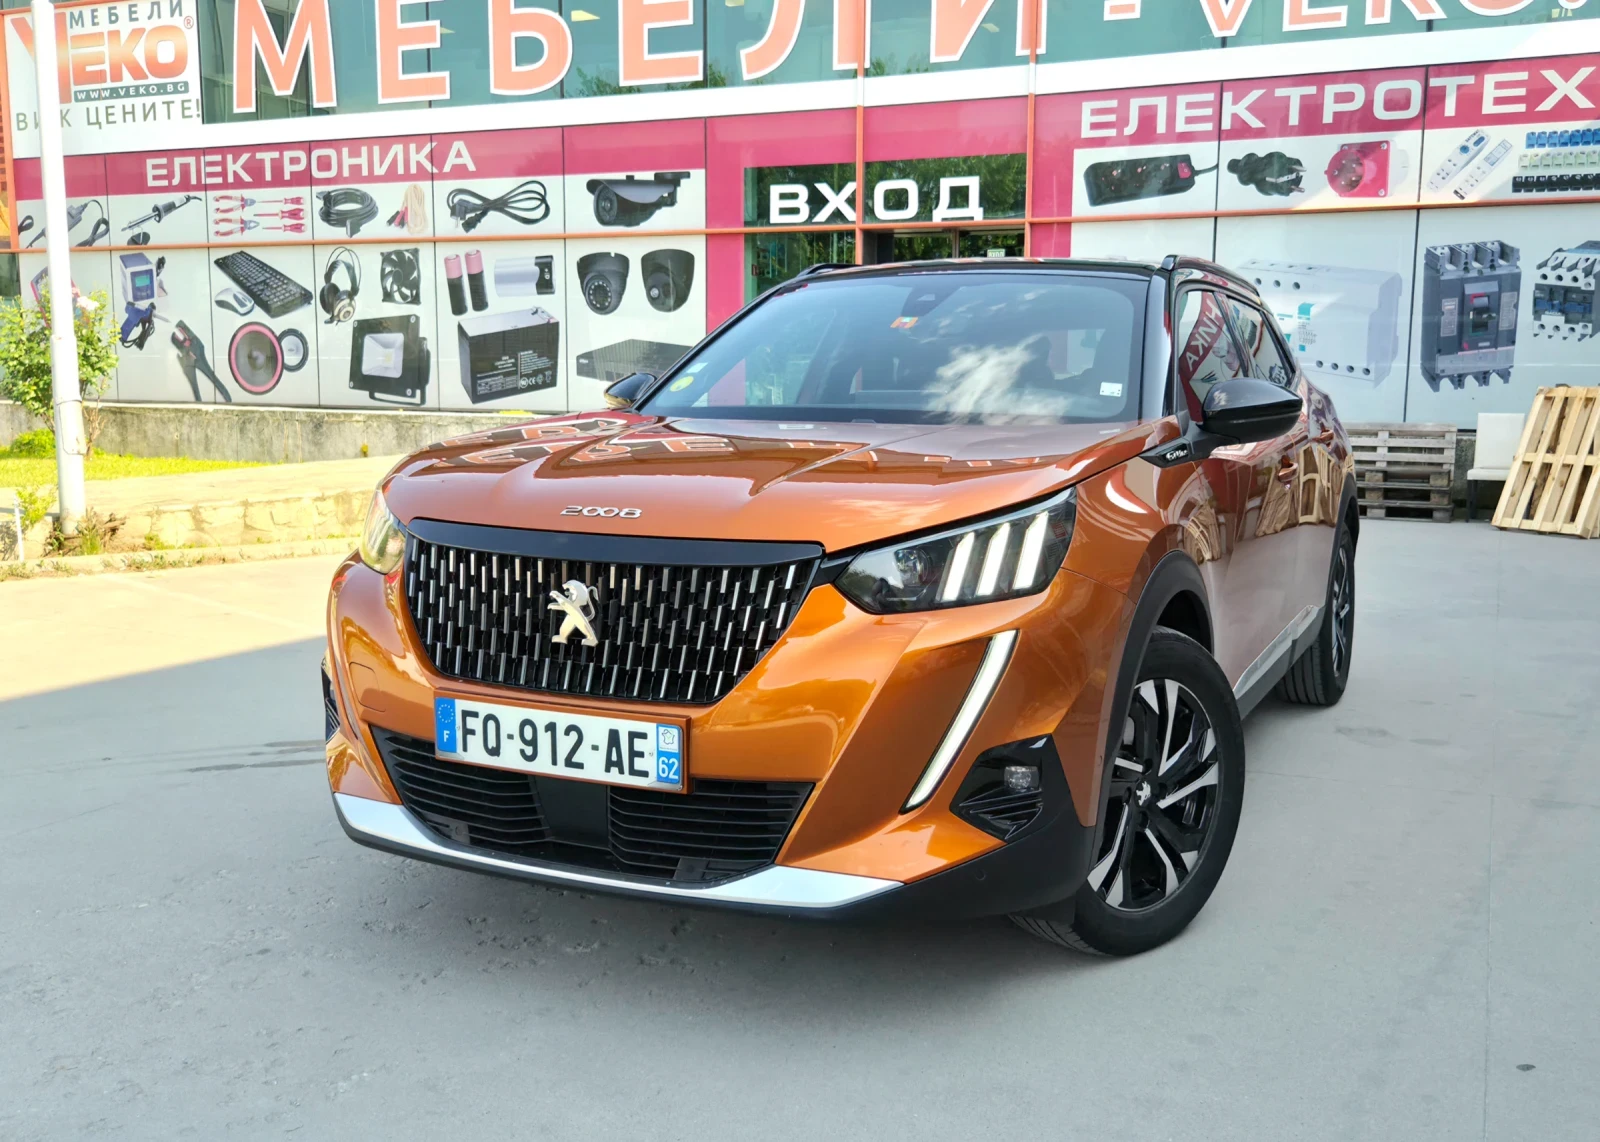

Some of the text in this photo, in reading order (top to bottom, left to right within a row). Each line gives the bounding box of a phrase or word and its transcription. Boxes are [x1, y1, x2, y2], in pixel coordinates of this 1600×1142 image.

[69, 0, 183, 29] МЕБЕЛИ
[76, 82, 186, 100] WWW.VEKO.BG
[1080, 66, 1597, 138] ЕЛЕКТРОТЕХ
[86, 98, 201, 130] ЦЕНИТЕ!
[146, 141, 476, 187] ЕЛЕКТРОНИКА
[769, 175, 984, 225] ВХОД
[560, 505, 642, 518] 2008
[443, 709, 679, 780] F FQ-912-AE 62
